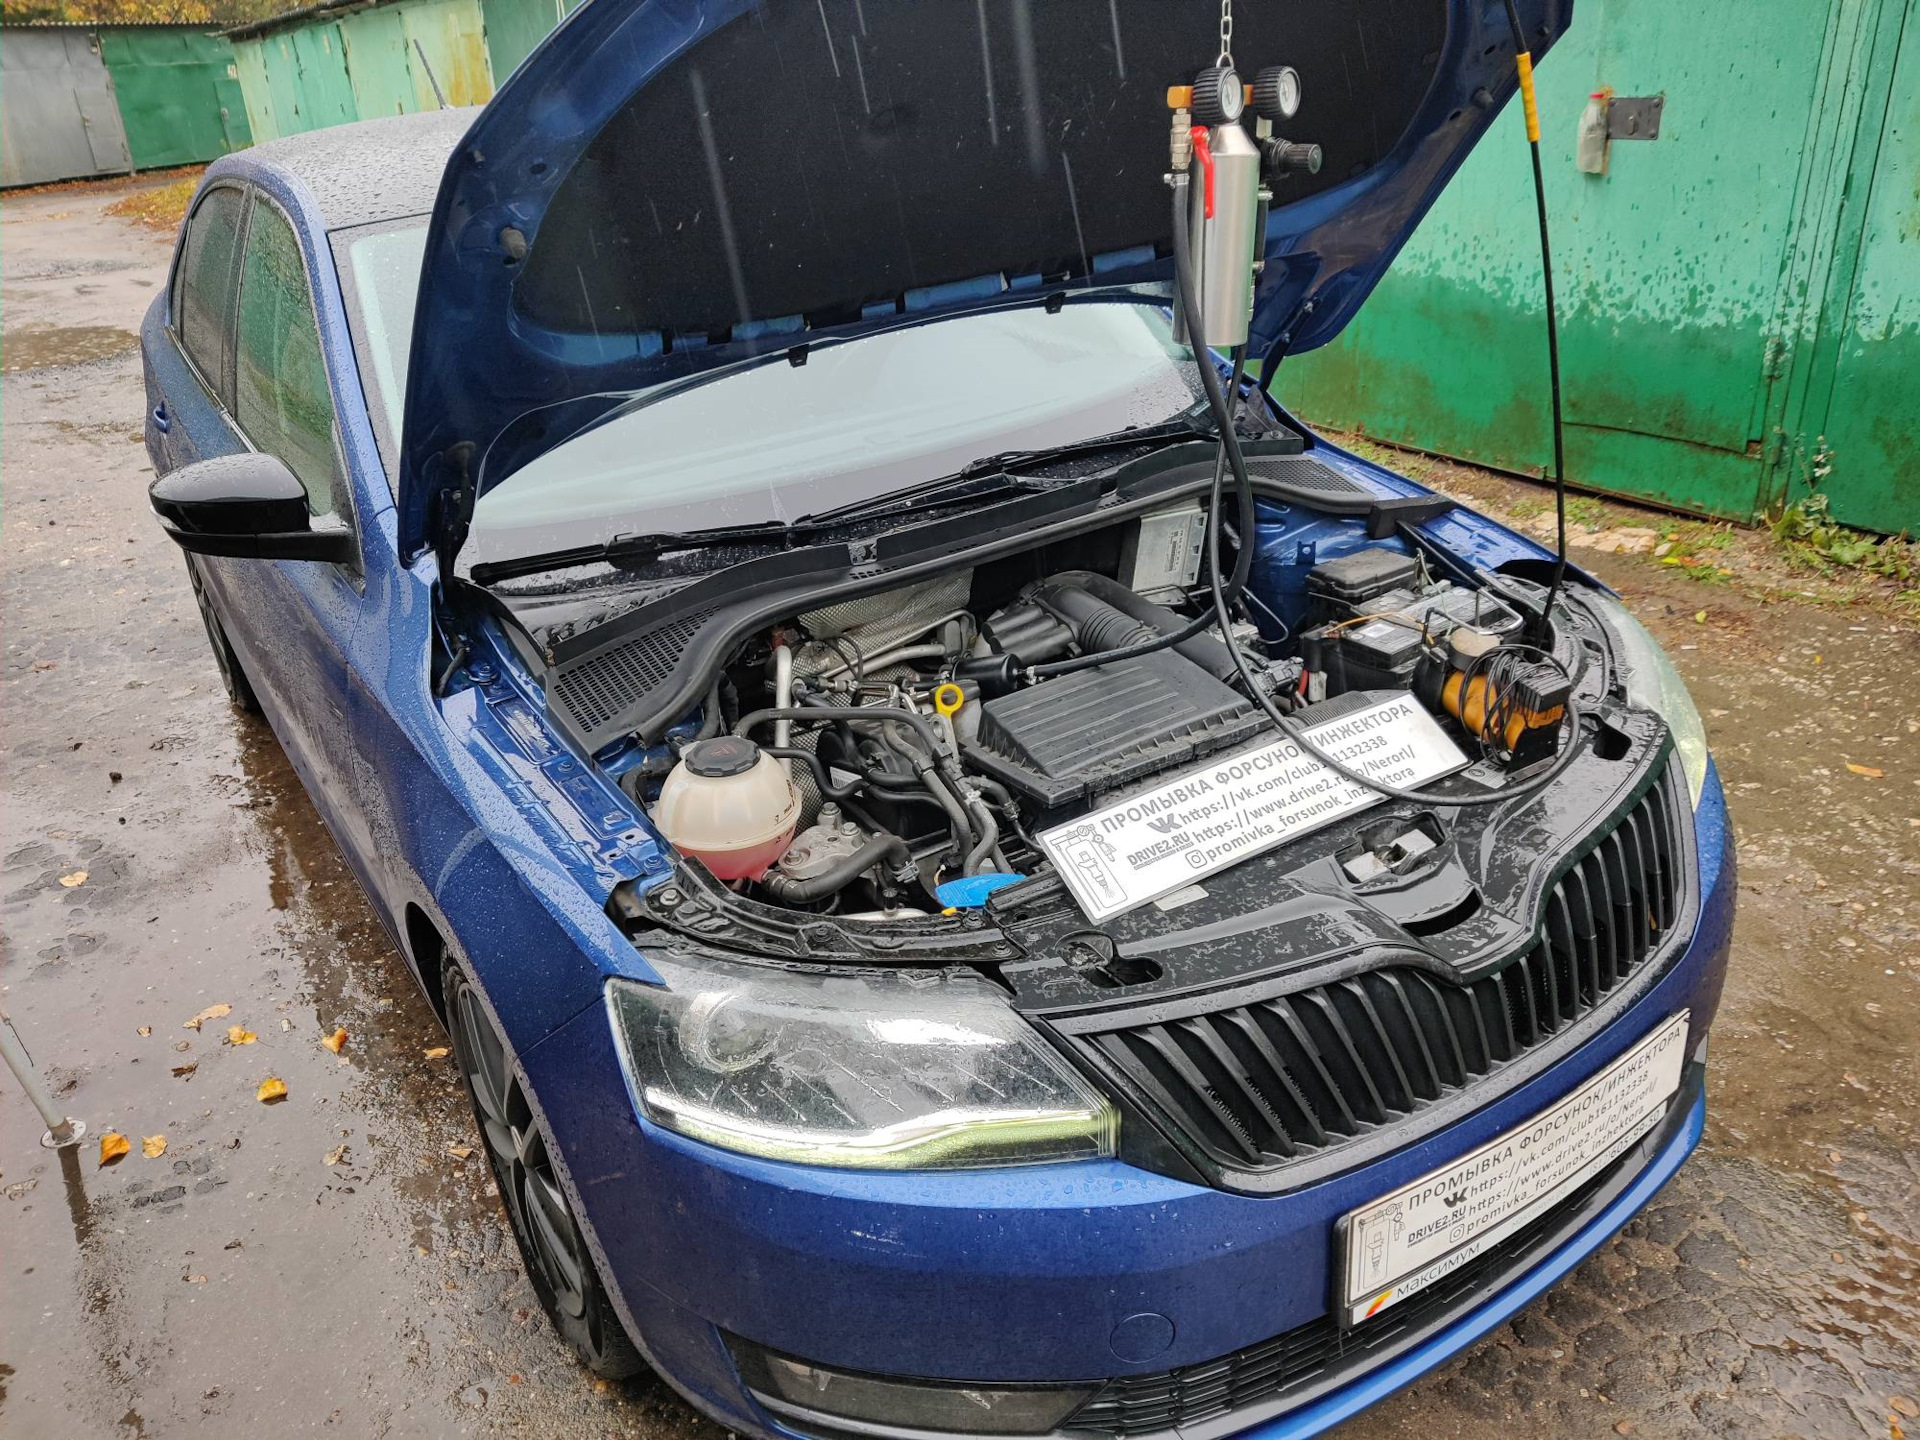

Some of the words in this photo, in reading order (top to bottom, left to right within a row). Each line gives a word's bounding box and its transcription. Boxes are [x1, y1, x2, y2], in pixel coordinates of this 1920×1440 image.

[1101, 779, 1214, 833] ПРОМЫВКА
[1215, 704, 1413, 785] ФОРСУНО/ИНЖЕКТОРА
[1179, 735, 1388, 825] https://vk.com/club11132338
[1206, 767, 1415, 862] promivka_forsunok_inzktora
[1126, 831, 1190, 866] DRIVE2.RU
[1409, 1147, 1513, 1210] ПРОМЫВКА
[1520, 1027, 1681, 1149] ФОРСУНОК/ИНЖЕКТОРА
[1408, 1206, 1466, 1244] DRIVE2.RU
